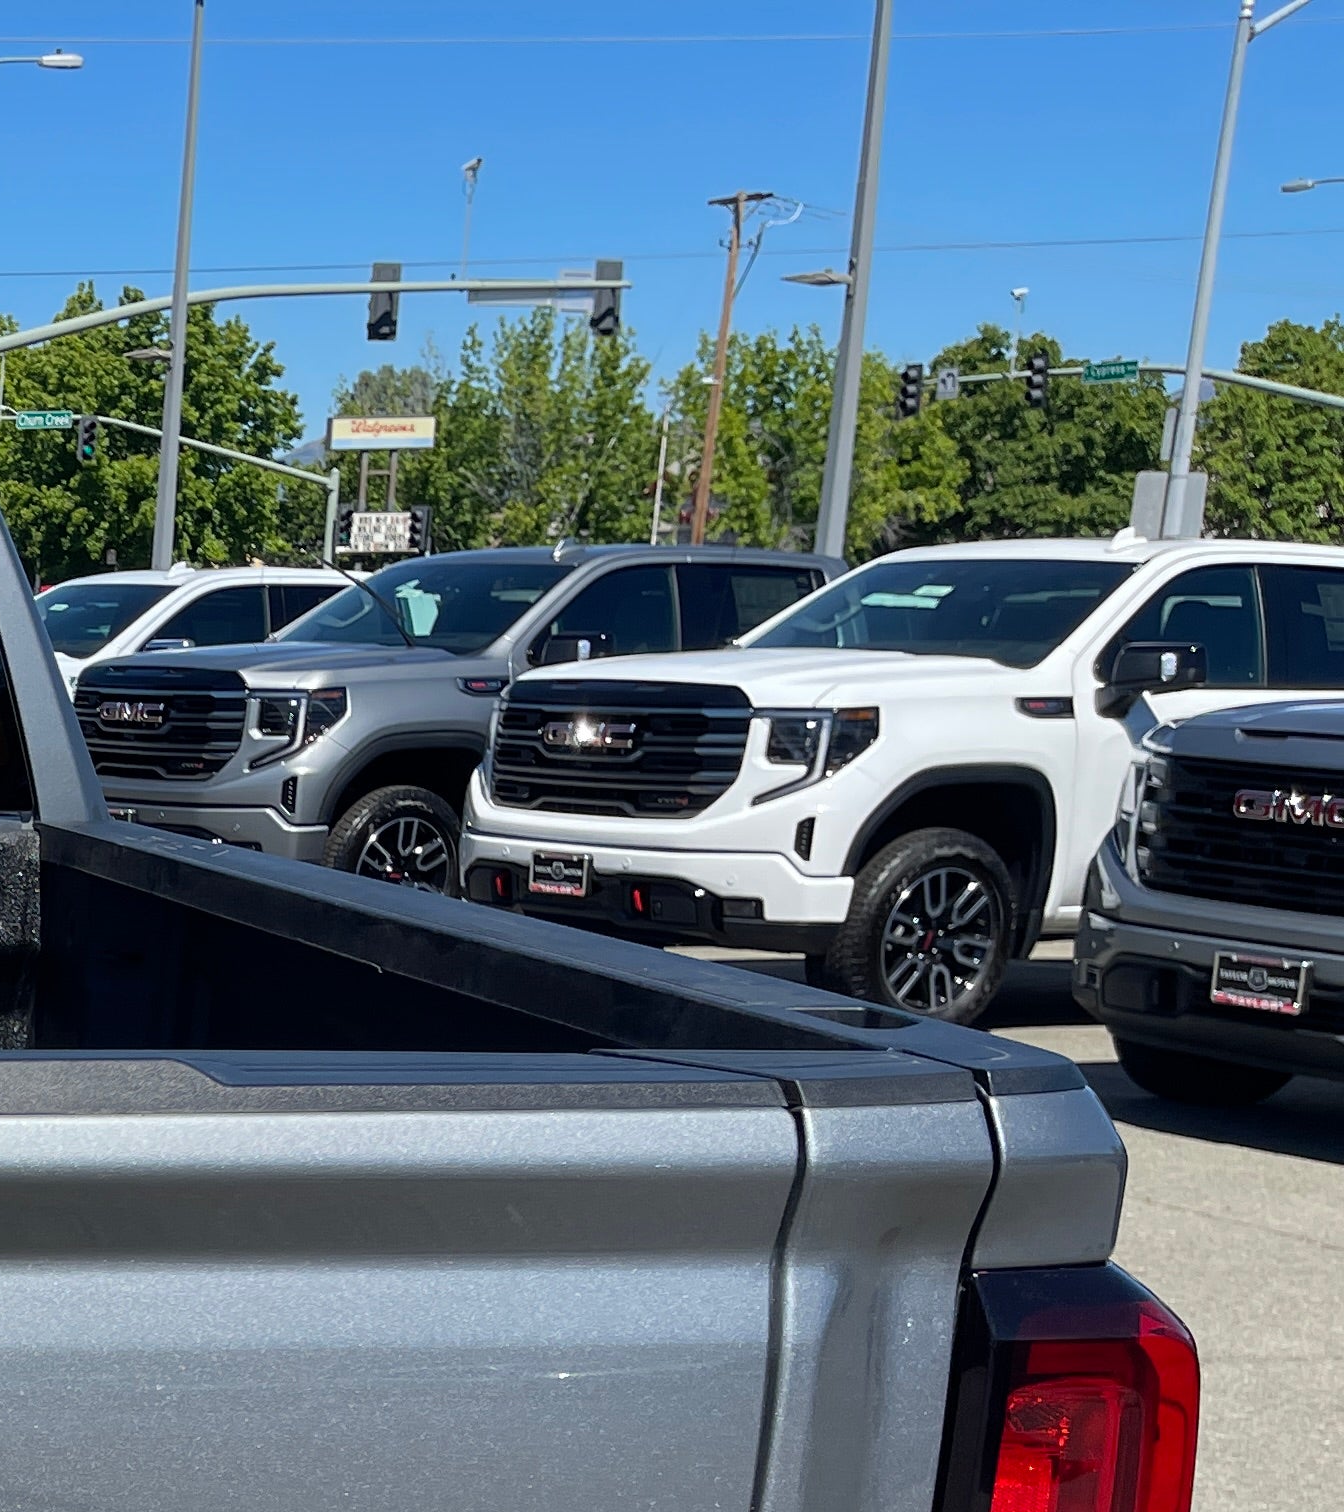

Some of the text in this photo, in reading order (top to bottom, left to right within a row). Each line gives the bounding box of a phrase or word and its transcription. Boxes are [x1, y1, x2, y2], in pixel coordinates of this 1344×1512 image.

[18, 413, 70, 427] Churn Creek
[98, 701, 164, 724] GMC
